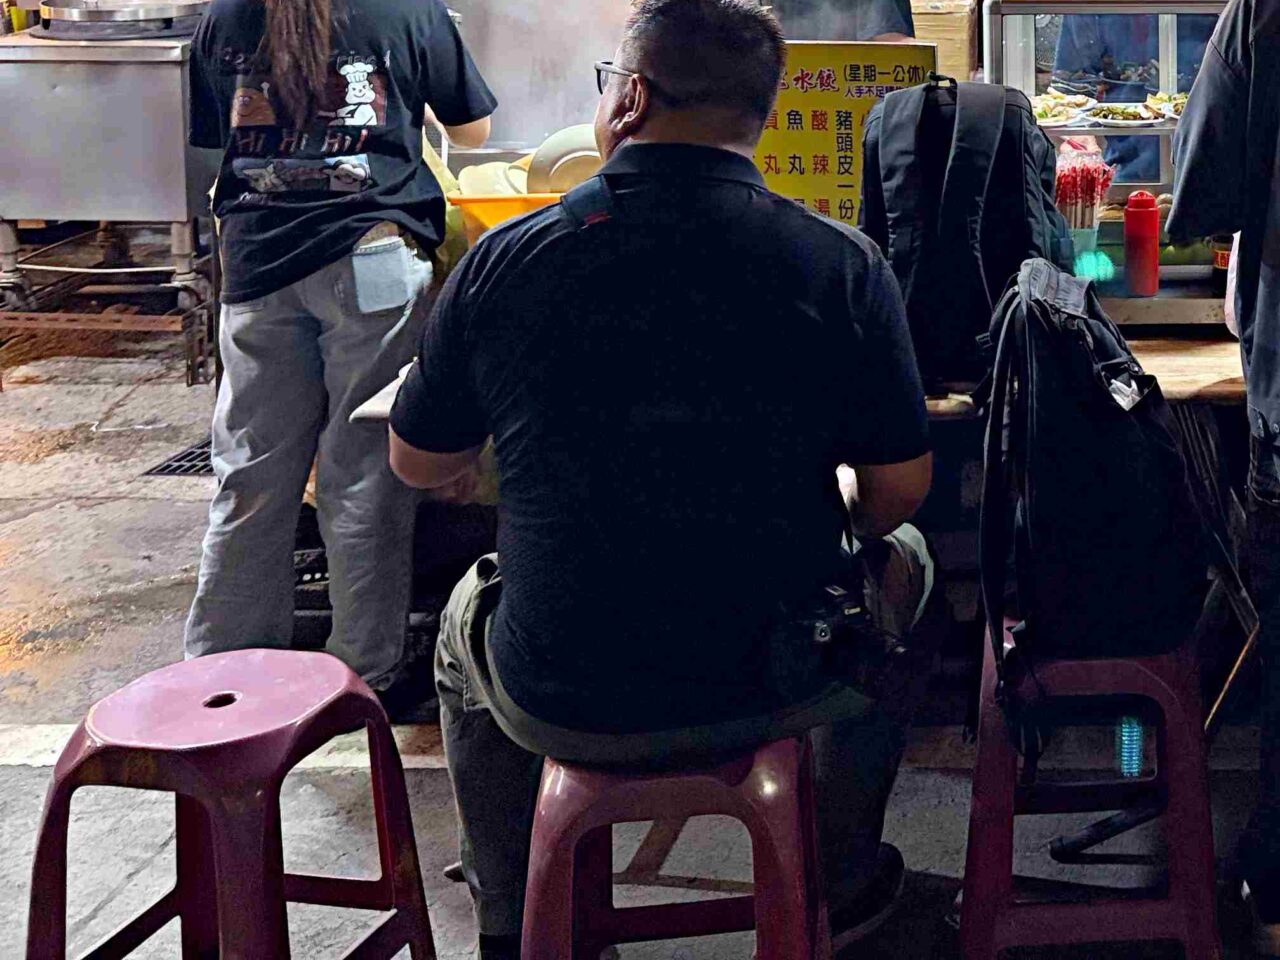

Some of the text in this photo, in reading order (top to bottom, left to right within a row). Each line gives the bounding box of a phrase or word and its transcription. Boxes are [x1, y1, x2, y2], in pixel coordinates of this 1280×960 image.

[835, 111, 855, 221] 豬頭皮一份
